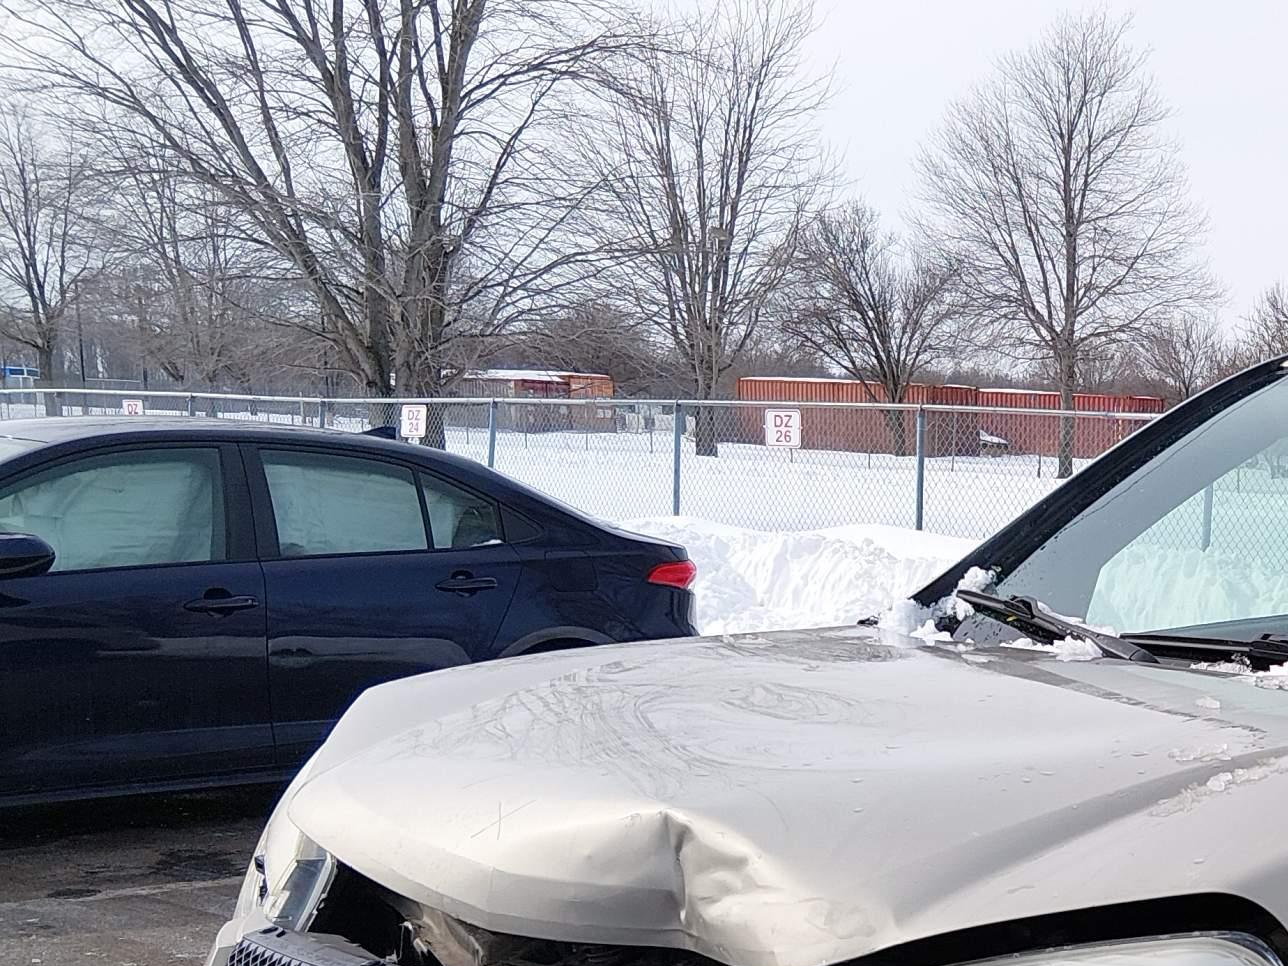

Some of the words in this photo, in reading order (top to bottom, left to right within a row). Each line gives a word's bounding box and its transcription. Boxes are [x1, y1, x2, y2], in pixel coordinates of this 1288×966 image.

[127, 403, 139, 415] DZ
[408, 409, 421, 421] DZ
[774, 414, 793, 428] DZ
[408, 422, 419, 433] 24
[775, 429, 792, 443] 26
